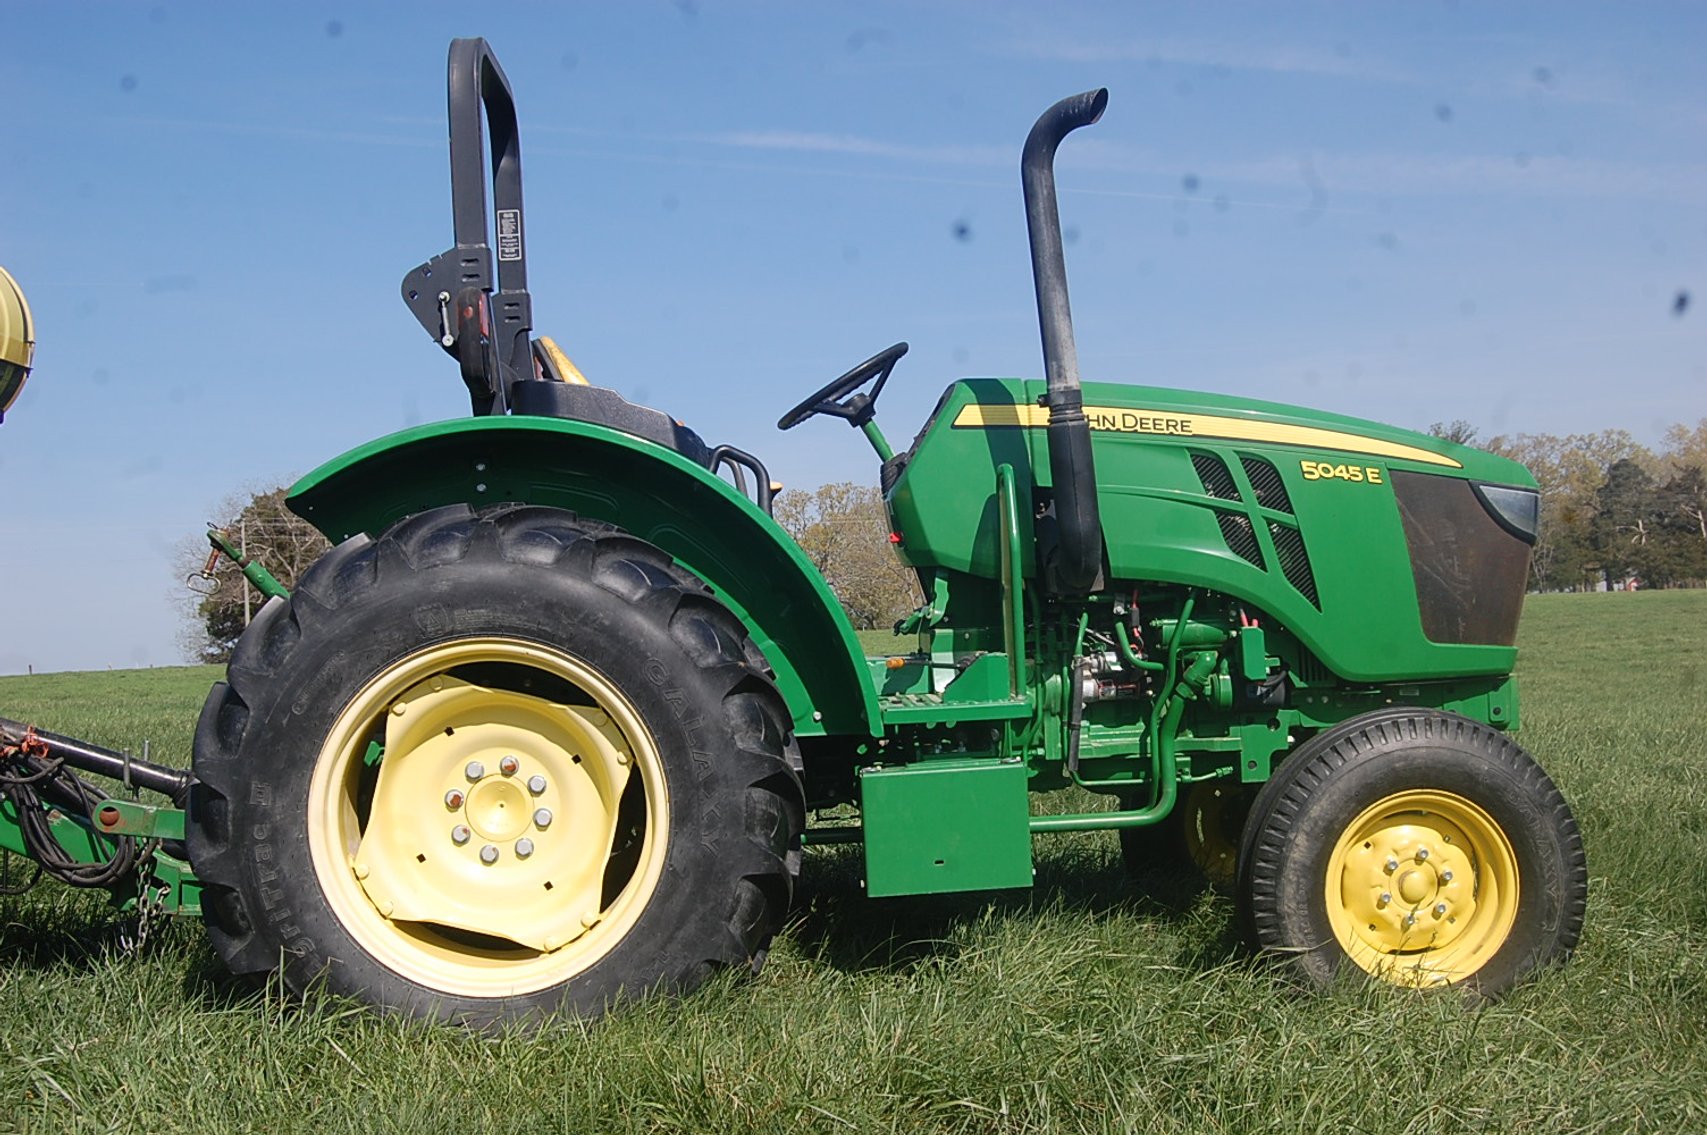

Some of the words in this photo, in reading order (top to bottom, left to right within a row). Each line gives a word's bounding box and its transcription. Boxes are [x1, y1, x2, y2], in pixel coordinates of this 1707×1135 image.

[1085, 413, 1117, 429] HN
[1121, 412, 1193, 434] DEERE
[1299, 459, 1364, 483] 5045
[1364, 466, 1383, 485] E
[645, 658, 722, 858] GALAXY
